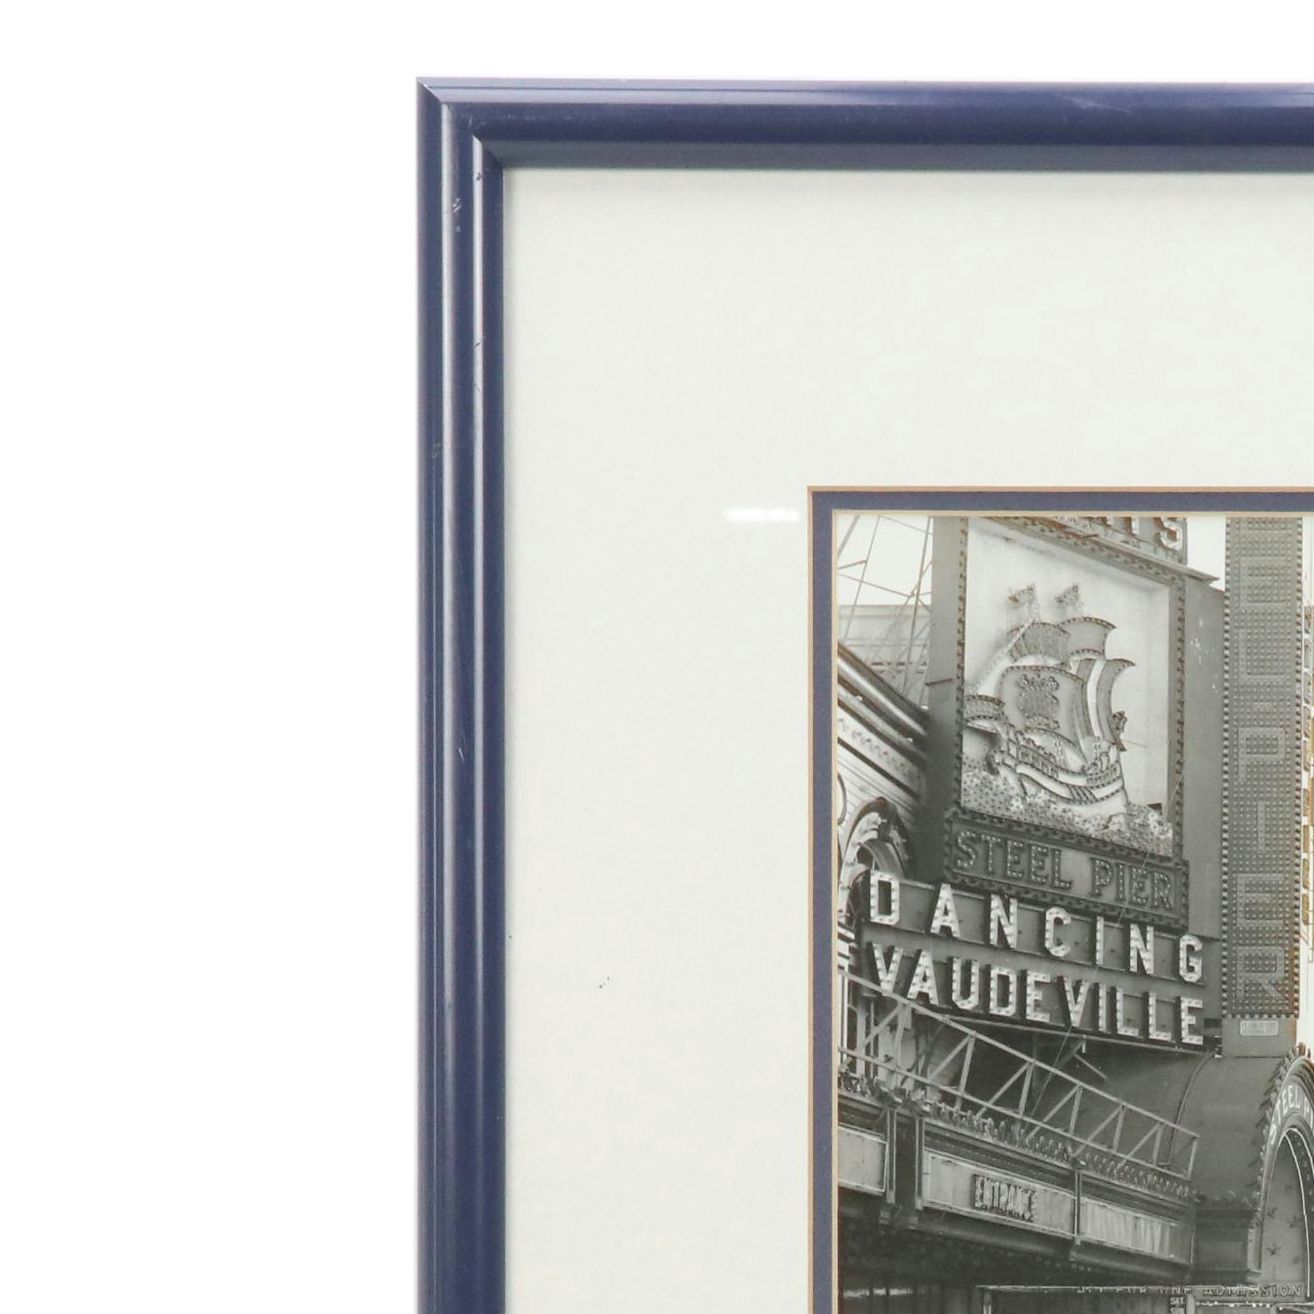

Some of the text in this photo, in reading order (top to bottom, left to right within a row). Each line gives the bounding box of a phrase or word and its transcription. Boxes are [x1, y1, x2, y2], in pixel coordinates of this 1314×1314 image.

[954, 829, 1175, 911] STEEL PIER
[868, 871, 1205, 984] DANCING
[870, 941, 1206, 1047] VAUDEVILLE
[974, 1174, 1035, 1222] ENTRANCE
